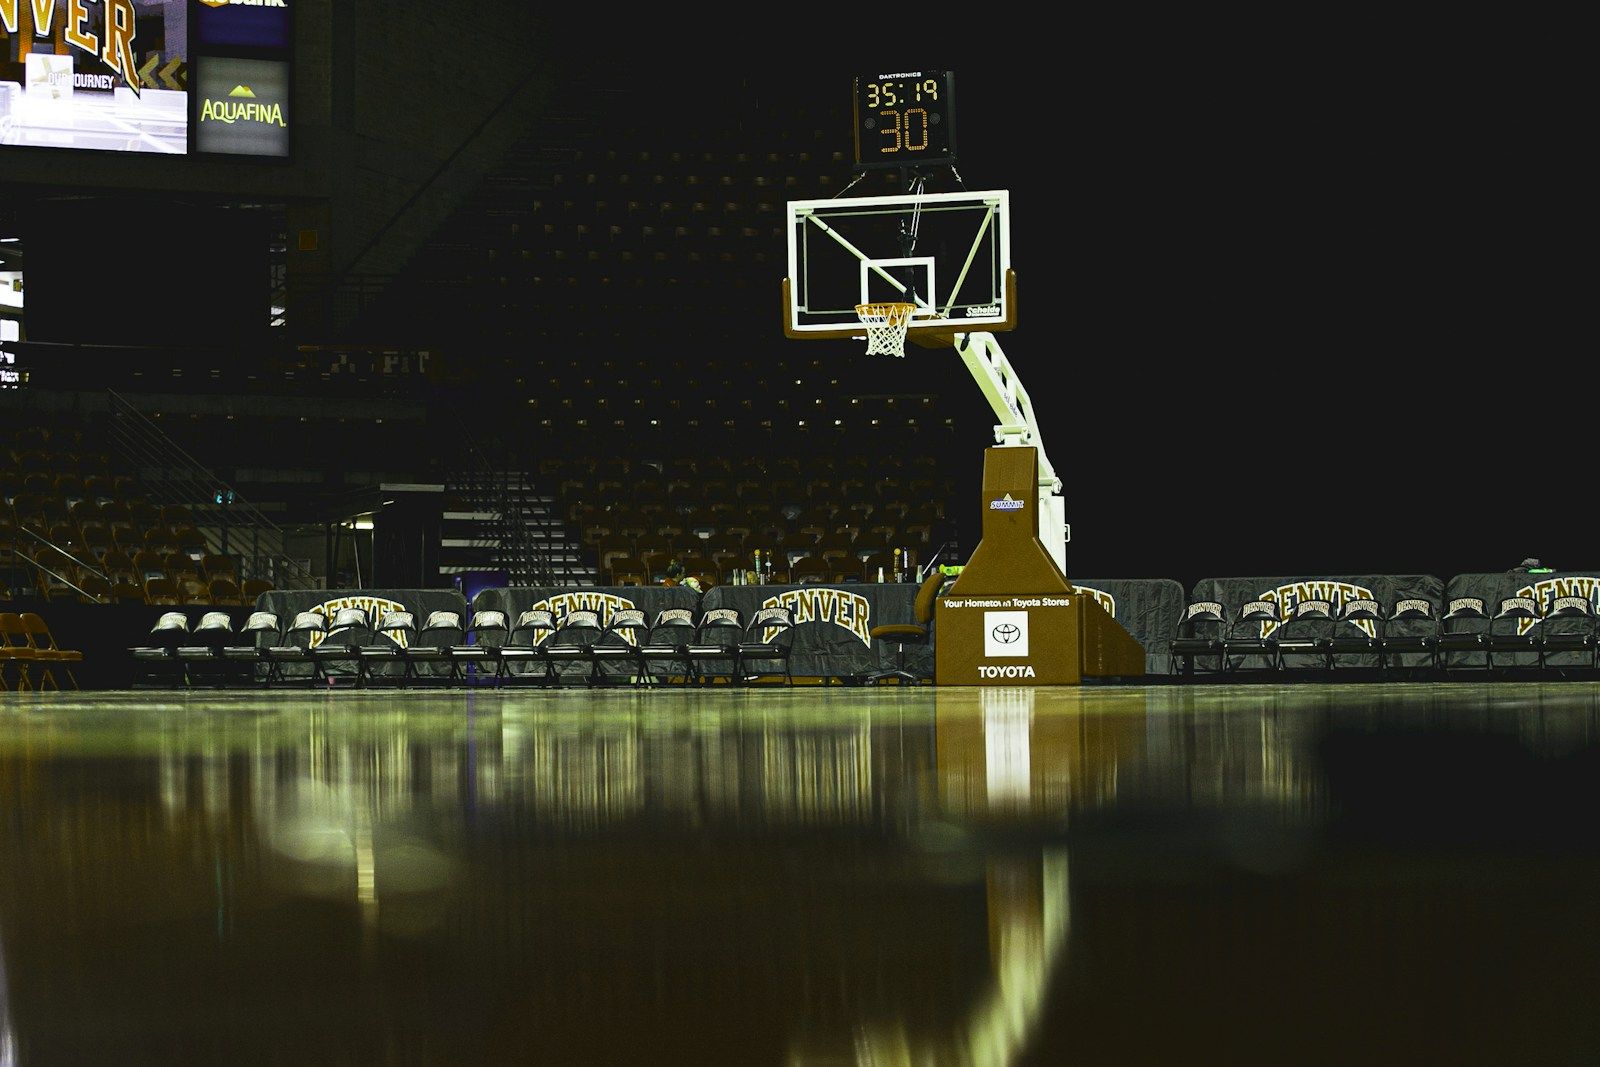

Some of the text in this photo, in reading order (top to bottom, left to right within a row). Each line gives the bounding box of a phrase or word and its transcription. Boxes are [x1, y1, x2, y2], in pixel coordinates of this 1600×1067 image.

[0, 0, 140, 98] VER
[879, 72, 922, 80] DAKTRONICS
[201, 98, 285, 127] AQUAFINA
[880, 108, 928, 153] 30
[990, 500, 1024, 510] SUMMIT
[944, 598, 1070, 609] Your Hometon Toyota Stores
[1188, 602, 1222, 619] DENVER
[1242, 601, 1276, 619] DENVER
[1297, 601, 1330, 618] DENVER
[1345, 600, 1379, 617] DENVER
[1396, 599, 1430, 617] DENVER
[1449, 598, 1483, 615] DENVER
[1501, 598, 1536, 615] DENVER
[1516, 577, 1600, 636] DENV
[1553, 598, 1588, 615] DENVER
[661, 608, 693, 625] DENVER
[707, 608, 739, 625] DENVER
[757, 607, 790, 625] DENVER
[978, 666, 1036, 678] TOYOTA
